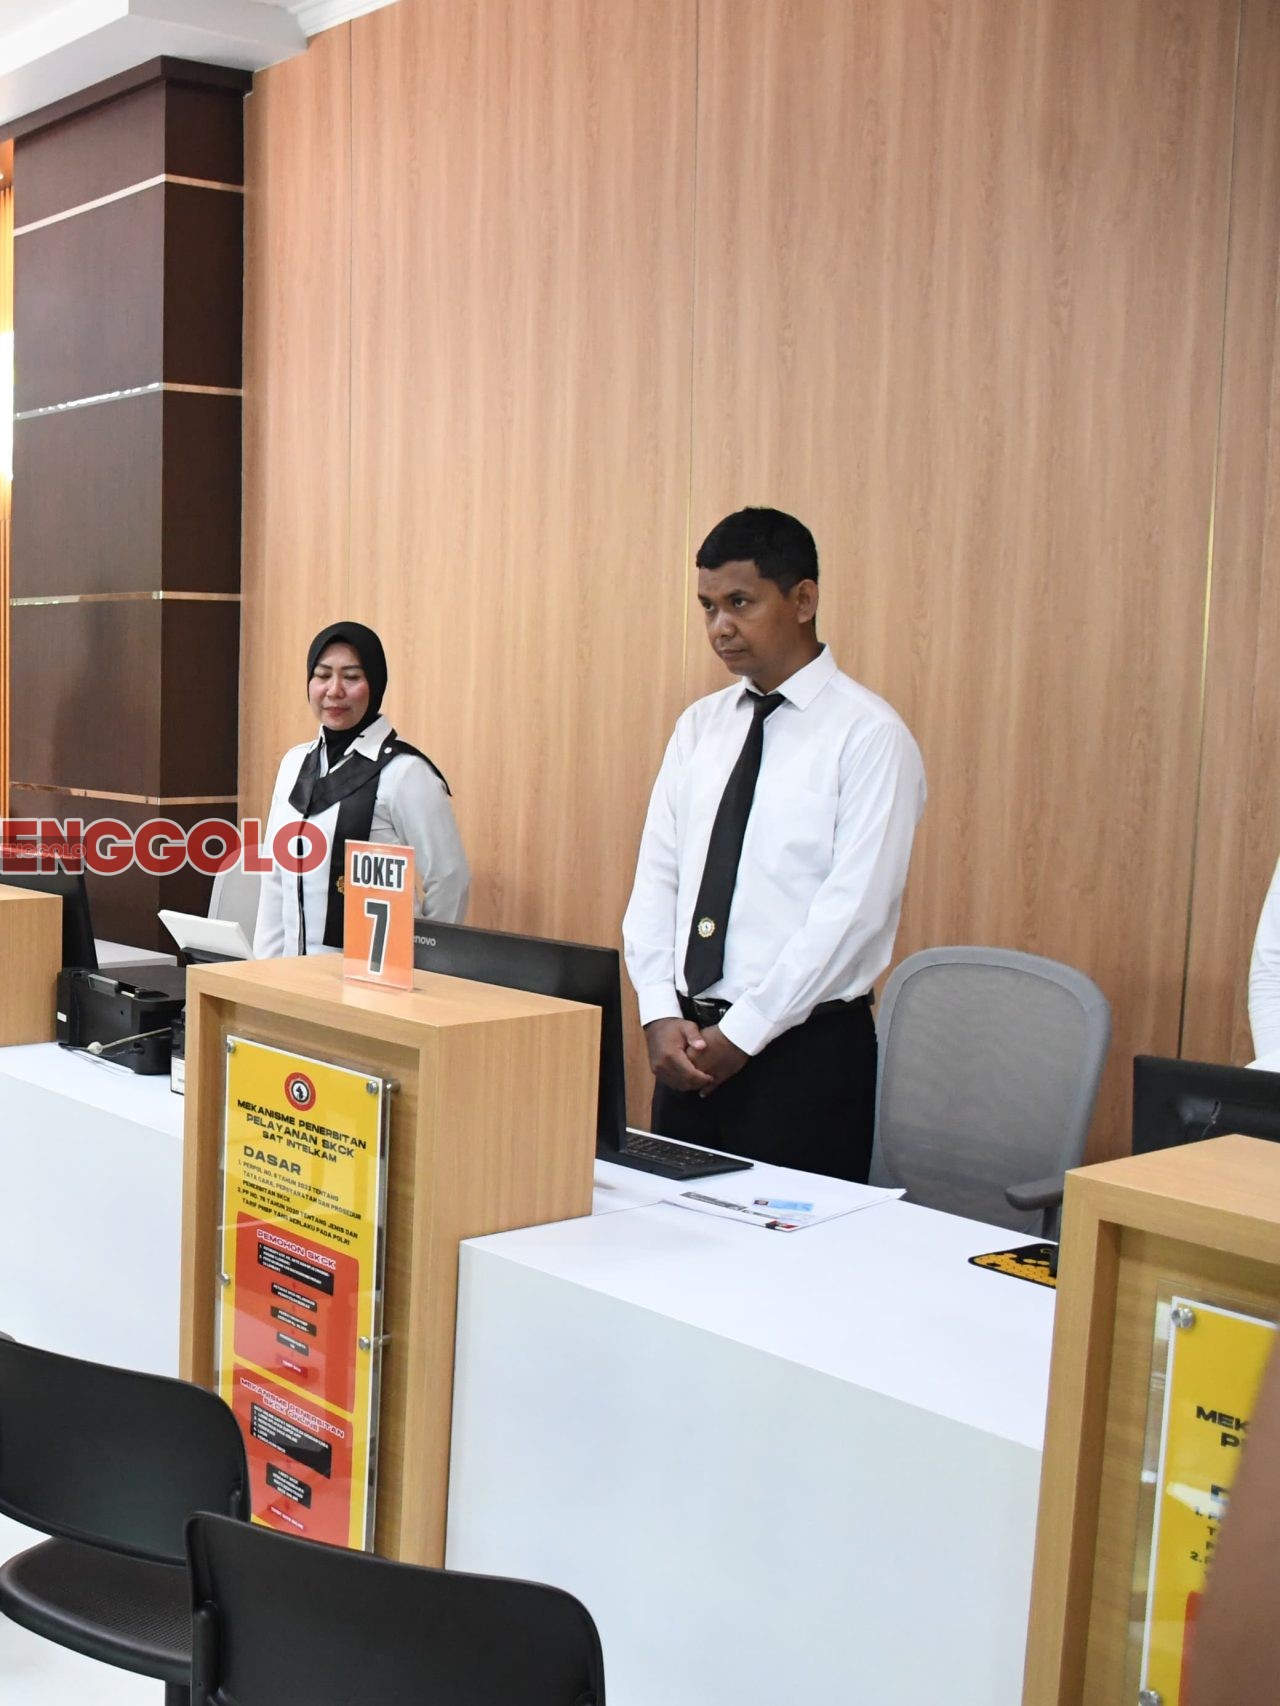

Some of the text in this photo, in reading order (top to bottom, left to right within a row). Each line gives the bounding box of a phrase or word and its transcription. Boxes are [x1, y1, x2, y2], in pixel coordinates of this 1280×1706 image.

[352, 852, 407, 890] LOKET
[365, 899, 390, 974] 7
[237, 1099, 366, 1149] MEKANISME PENERBITAN
[246, 1113, 354, 1158] PELAYANAN SKCK
[243, 1145, 302, 1175] DASAR
[262, 1130, 337, 1163] SAT INTELKAM
[266, 1198, 285, 1210] TAHUN
[278, 1174, 297, 1186] TAHUN
[311, 1186, 339, 1202] TENTANG
[330, 1204, 362, 1220] PROSEDUR
[258, 1229, 305, 1256] PEMOHON
[307, 1251, 336, 1269] SKCK
[241, 1378, 288, 1408] MEKANISME
[288, 1404, 345, 1438] PENERBITAN
[287, 1410, 319, 1432] ONLINE
